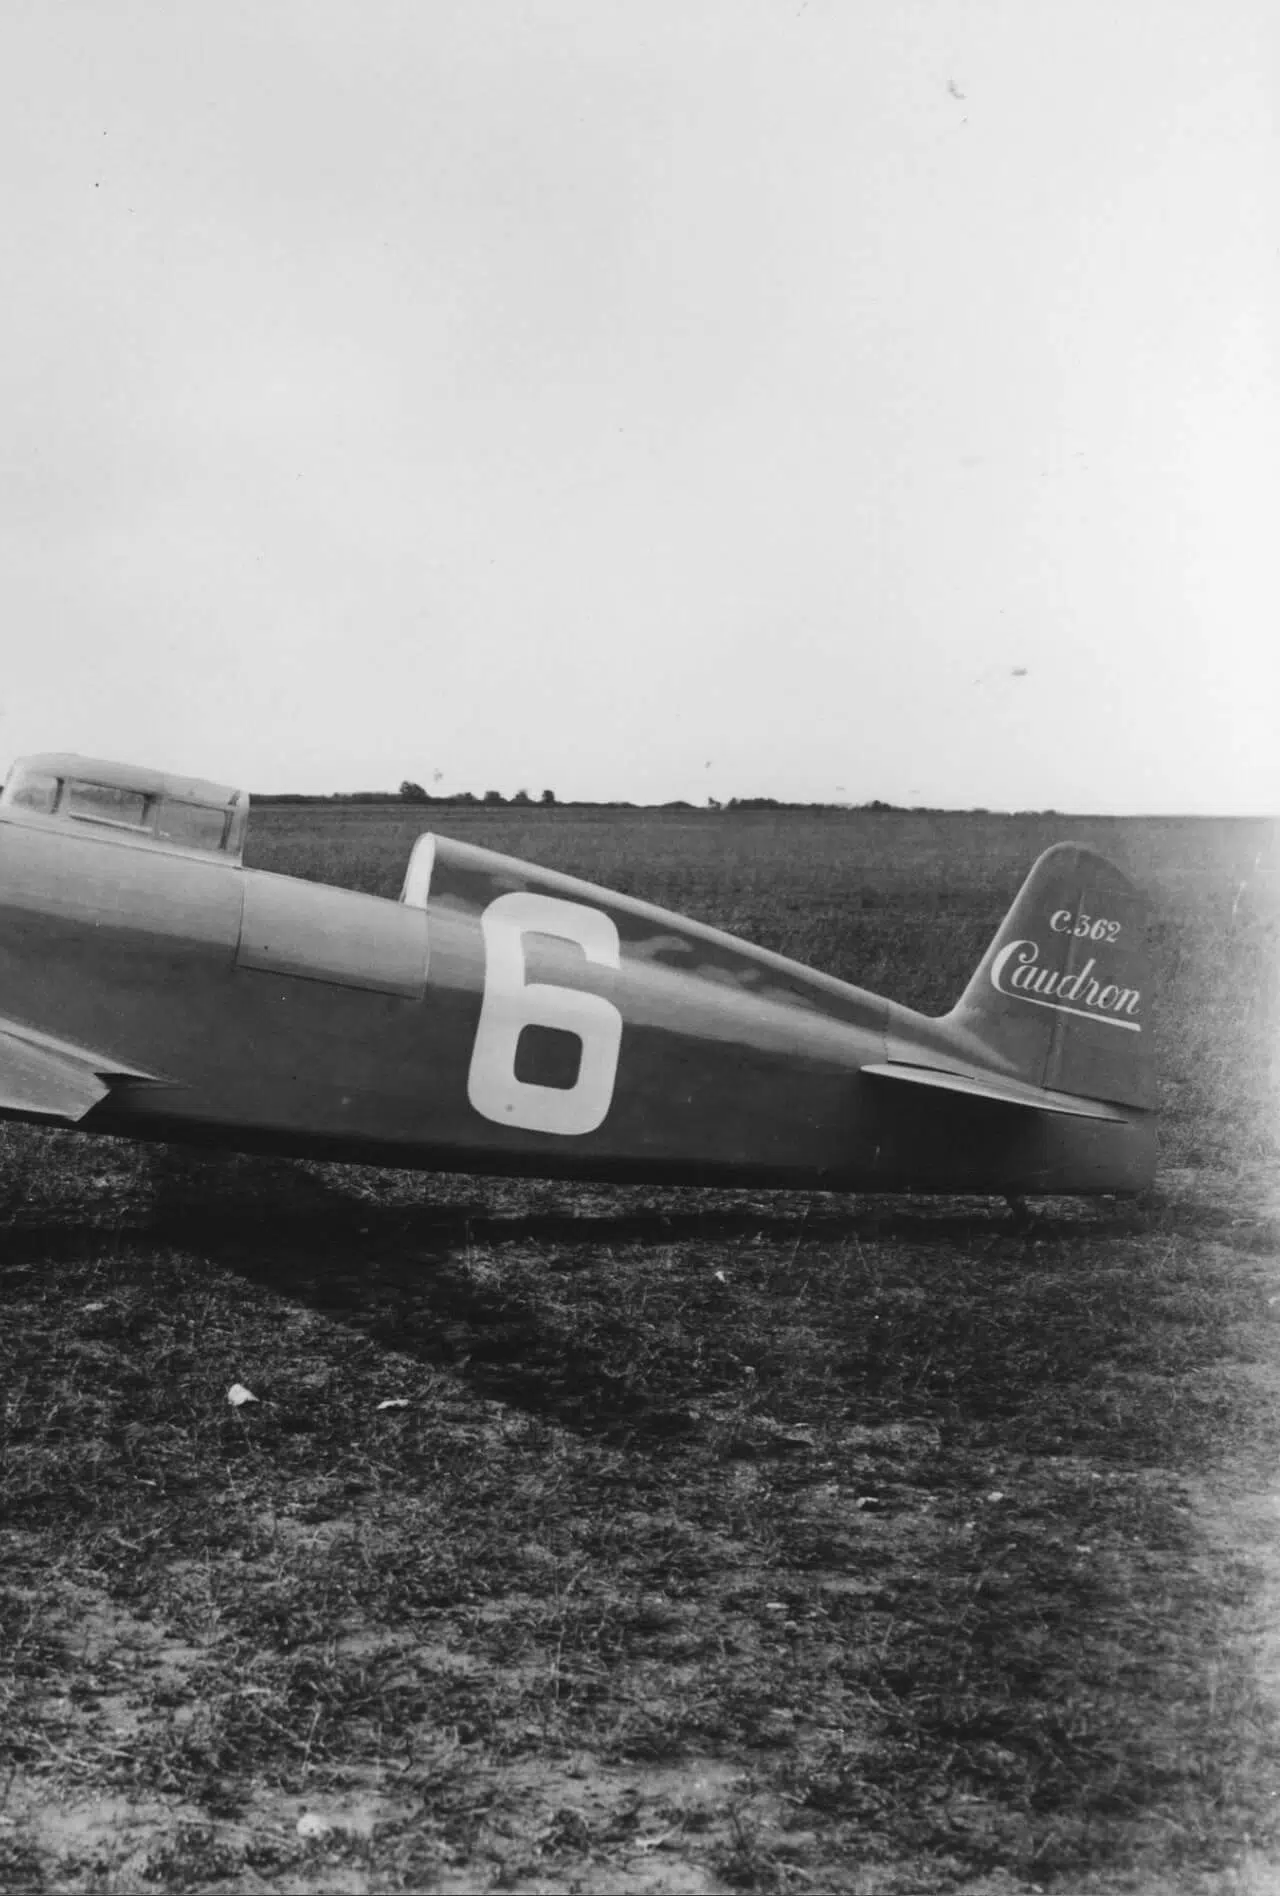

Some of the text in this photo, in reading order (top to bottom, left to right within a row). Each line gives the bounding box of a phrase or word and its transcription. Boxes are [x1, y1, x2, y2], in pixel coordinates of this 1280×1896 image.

[1050, 910, 1121, 943] C.362
[468, 892, 623, 1135] 6
[990, 939, 1141, 1031] Caudron
